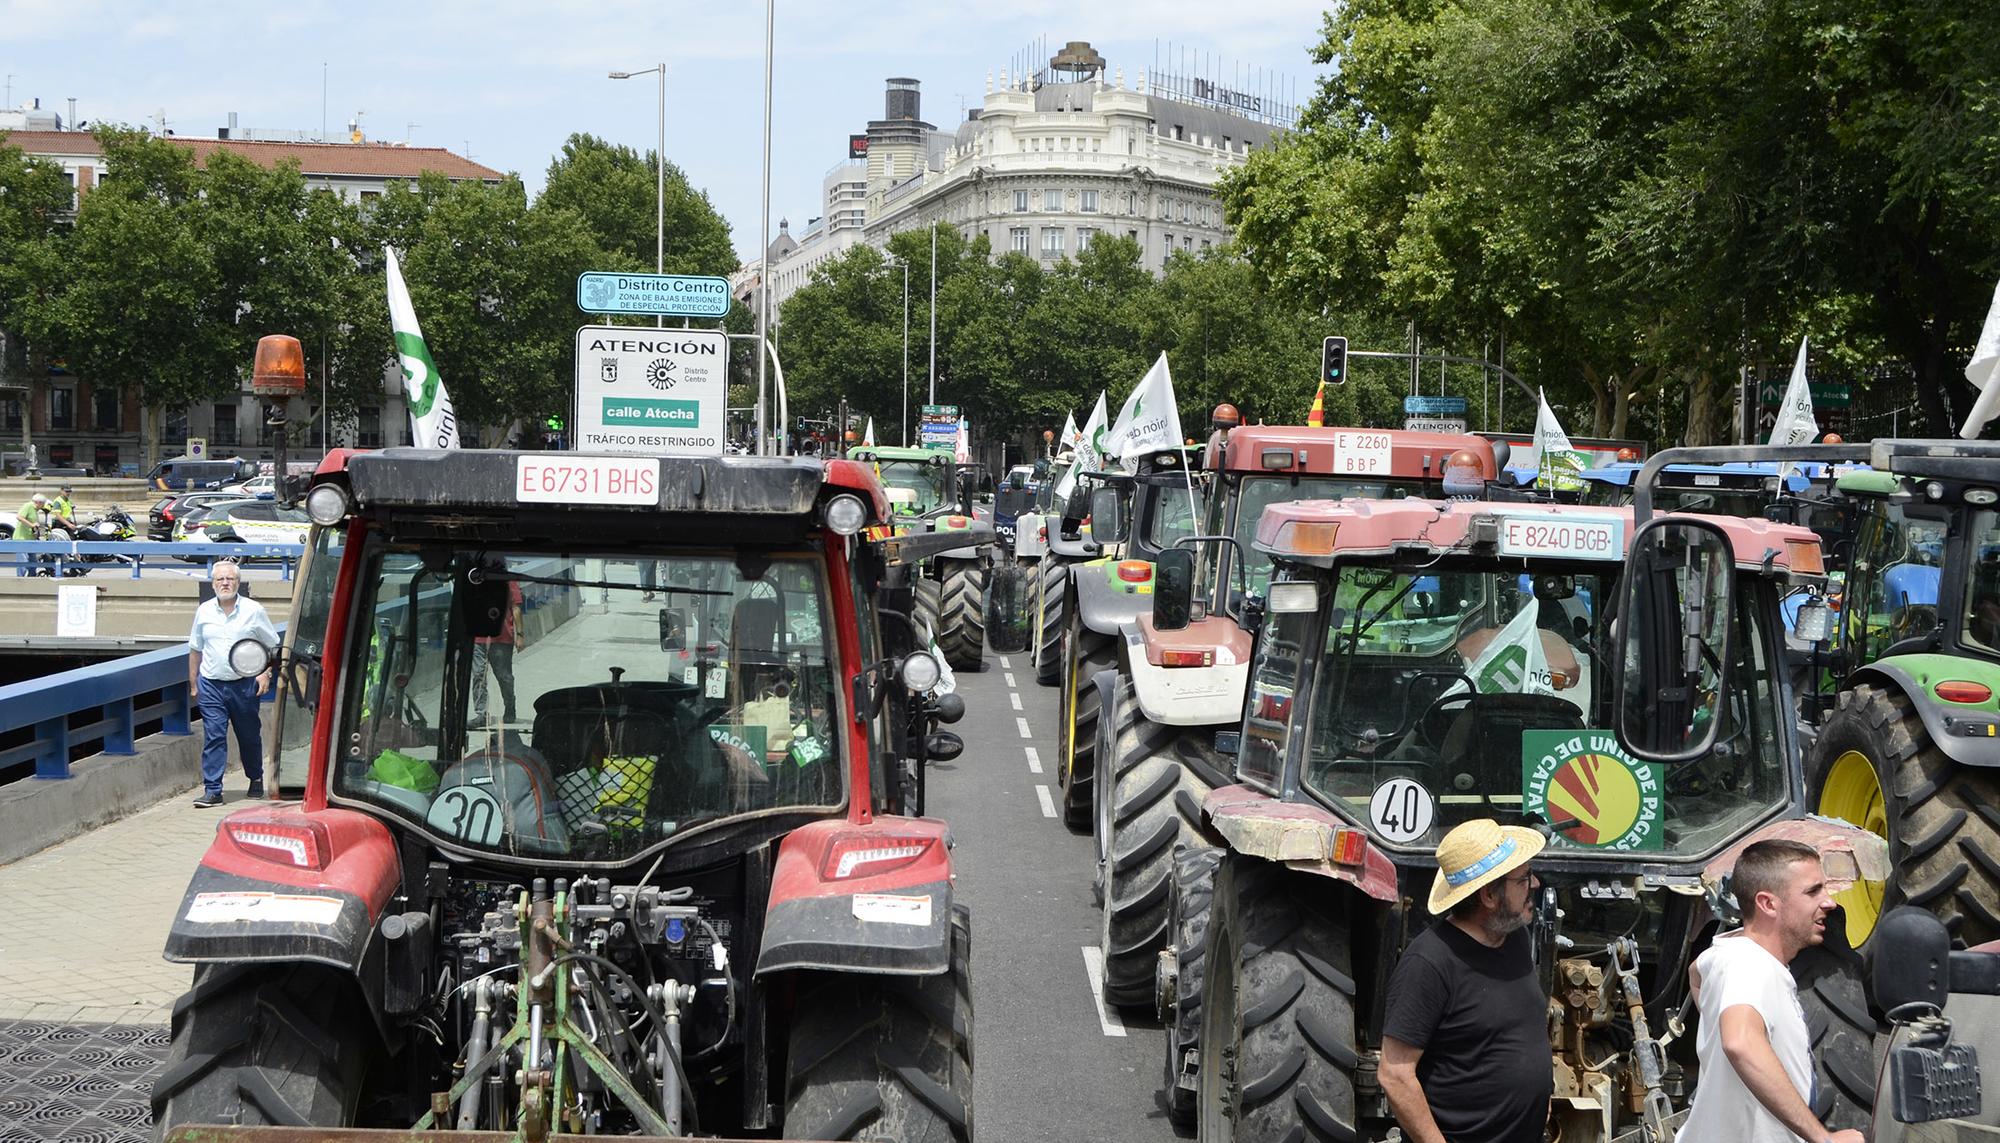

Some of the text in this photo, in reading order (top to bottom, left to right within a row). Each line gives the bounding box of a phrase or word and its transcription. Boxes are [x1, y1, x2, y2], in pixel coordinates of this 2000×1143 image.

[1220, 88, 1261, 112] HOTELS
[618, 278, 724, 294] Distrito Centro
[655, 294, 679, 302] BAJAS
[682, 295, 723, 303] EMISIONES
[633, 302, 669, 310] ESPECIAL
[672, 303, 721, 312] PROTECCIÓN
[589, 339, 716, 355] ATENCIÓN
[685, 367, 708, 375] Distrito
[607, 407, 695, 420] calle Atocha
[586, 433, 715, 447] TRÁFICO RESTRINGIDO
[1339, 435, 1388, 449] E 2260
[1347, 458, 1377, 472] BBP
[523, 466, 654, 494] E 6731 BHS
[996, 526, 1016, 535] POL
[1509, 525, 1608, 551] E 8240 BGB
[1554, 737, 1584, 760] DE
[1634, 765, 1657, 793] DE
[1381, 784, 1419, 834] 40
[445, 792, 494, 844] 30
